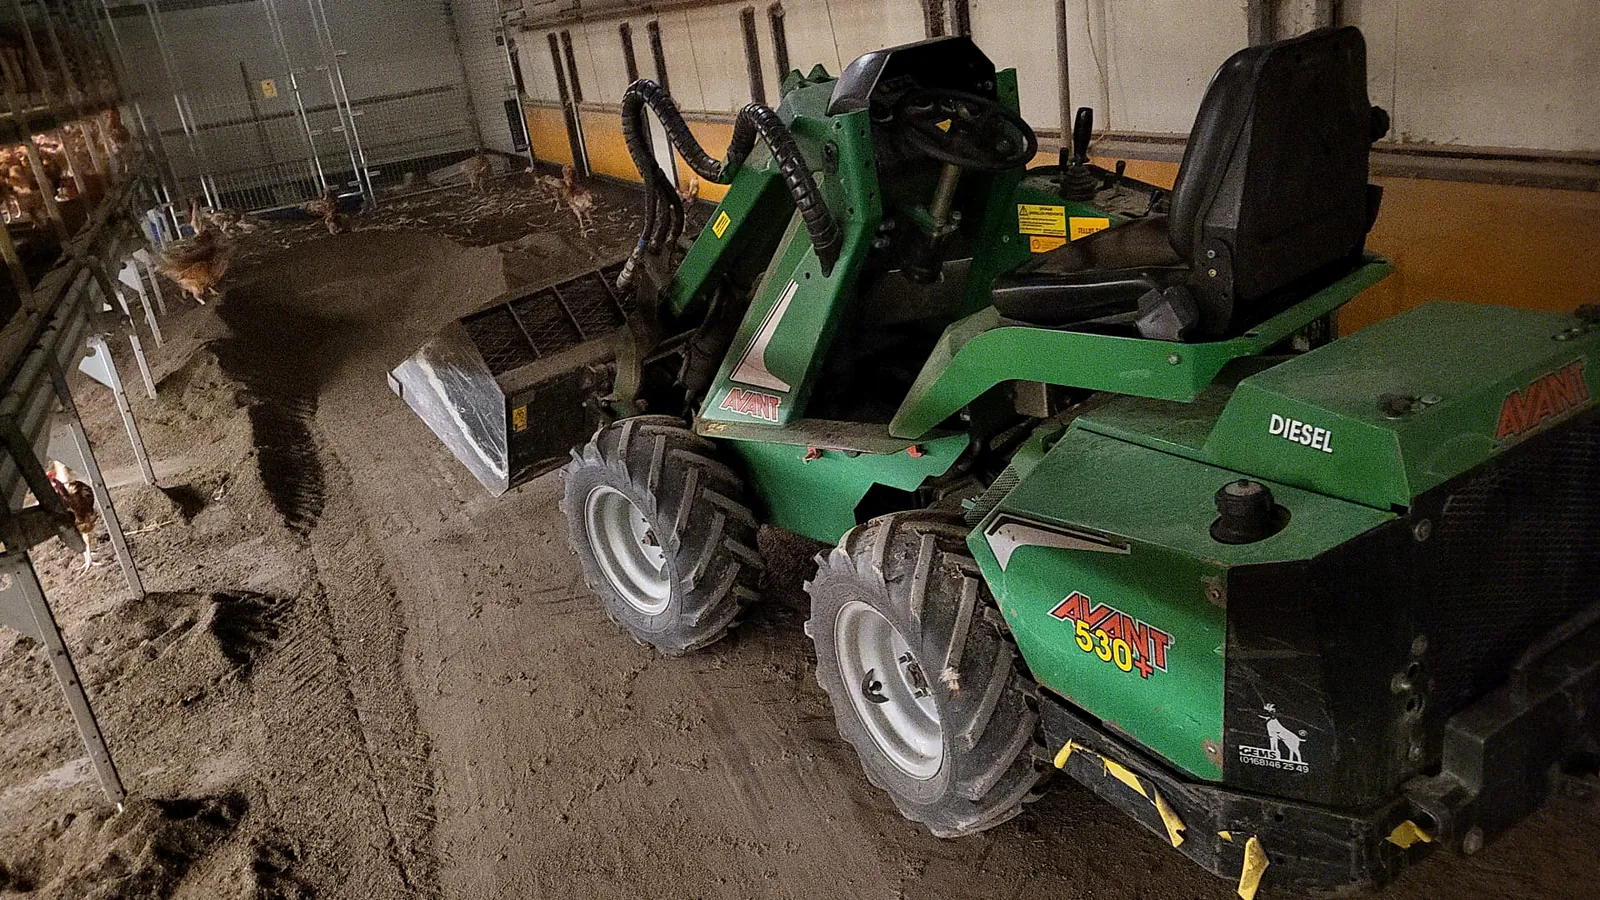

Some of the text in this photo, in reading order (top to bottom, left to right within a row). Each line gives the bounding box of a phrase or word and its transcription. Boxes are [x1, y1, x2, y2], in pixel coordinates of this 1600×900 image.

[719, 387, 781, 422] AVANT
[1494, 358, 1590, 442] AVANT
[1269, 413, 1333, 453] DIESEL
[1047, 591, 1169, 673] AVANT
[1075, 619, 1154, 680] 530+
